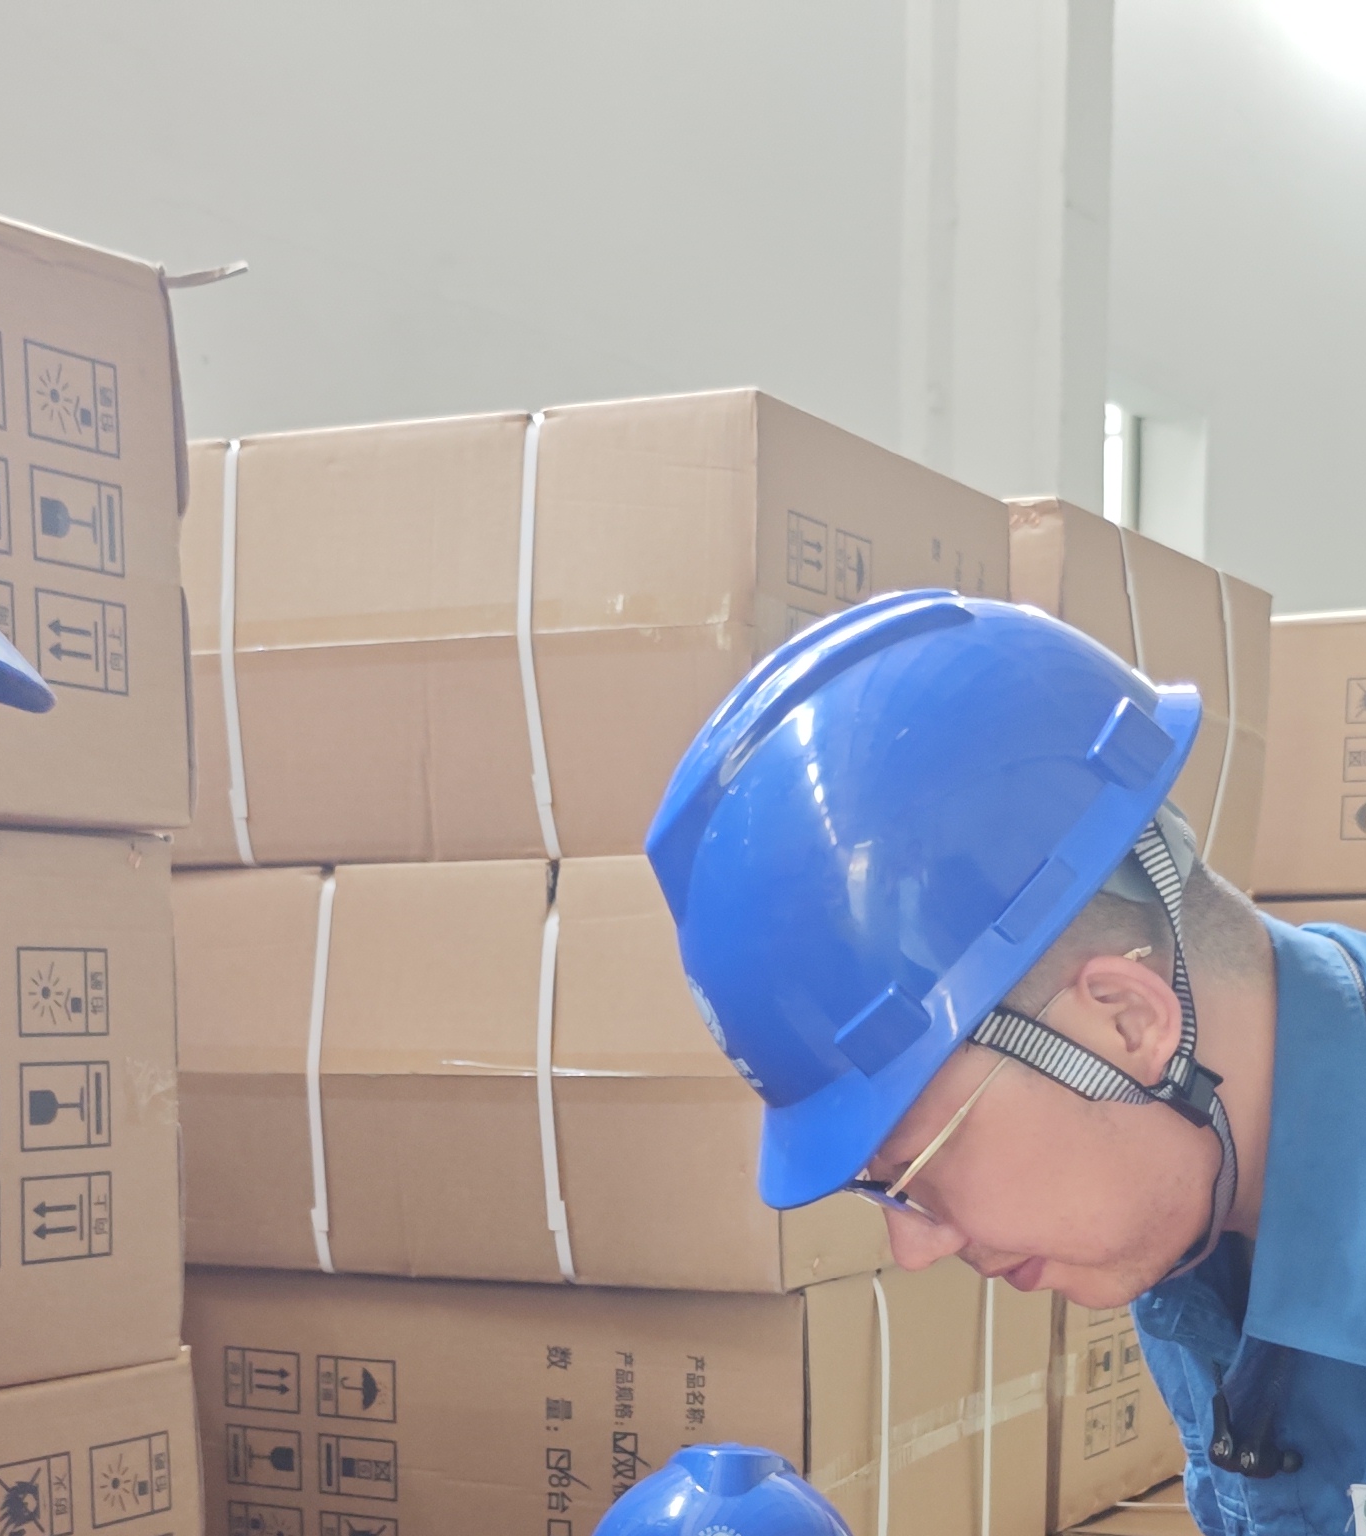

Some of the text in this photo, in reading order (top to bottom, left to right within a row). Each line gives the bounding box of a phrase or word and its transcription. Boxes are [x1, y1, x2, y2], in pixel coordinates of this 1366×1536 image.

[106, 627, 124, 672] 向上
[90, 970, 104, 1015] 怕晒
[93, 1193, 108, 1236] 向上
[52, 1473, 69, 1516] 防火
